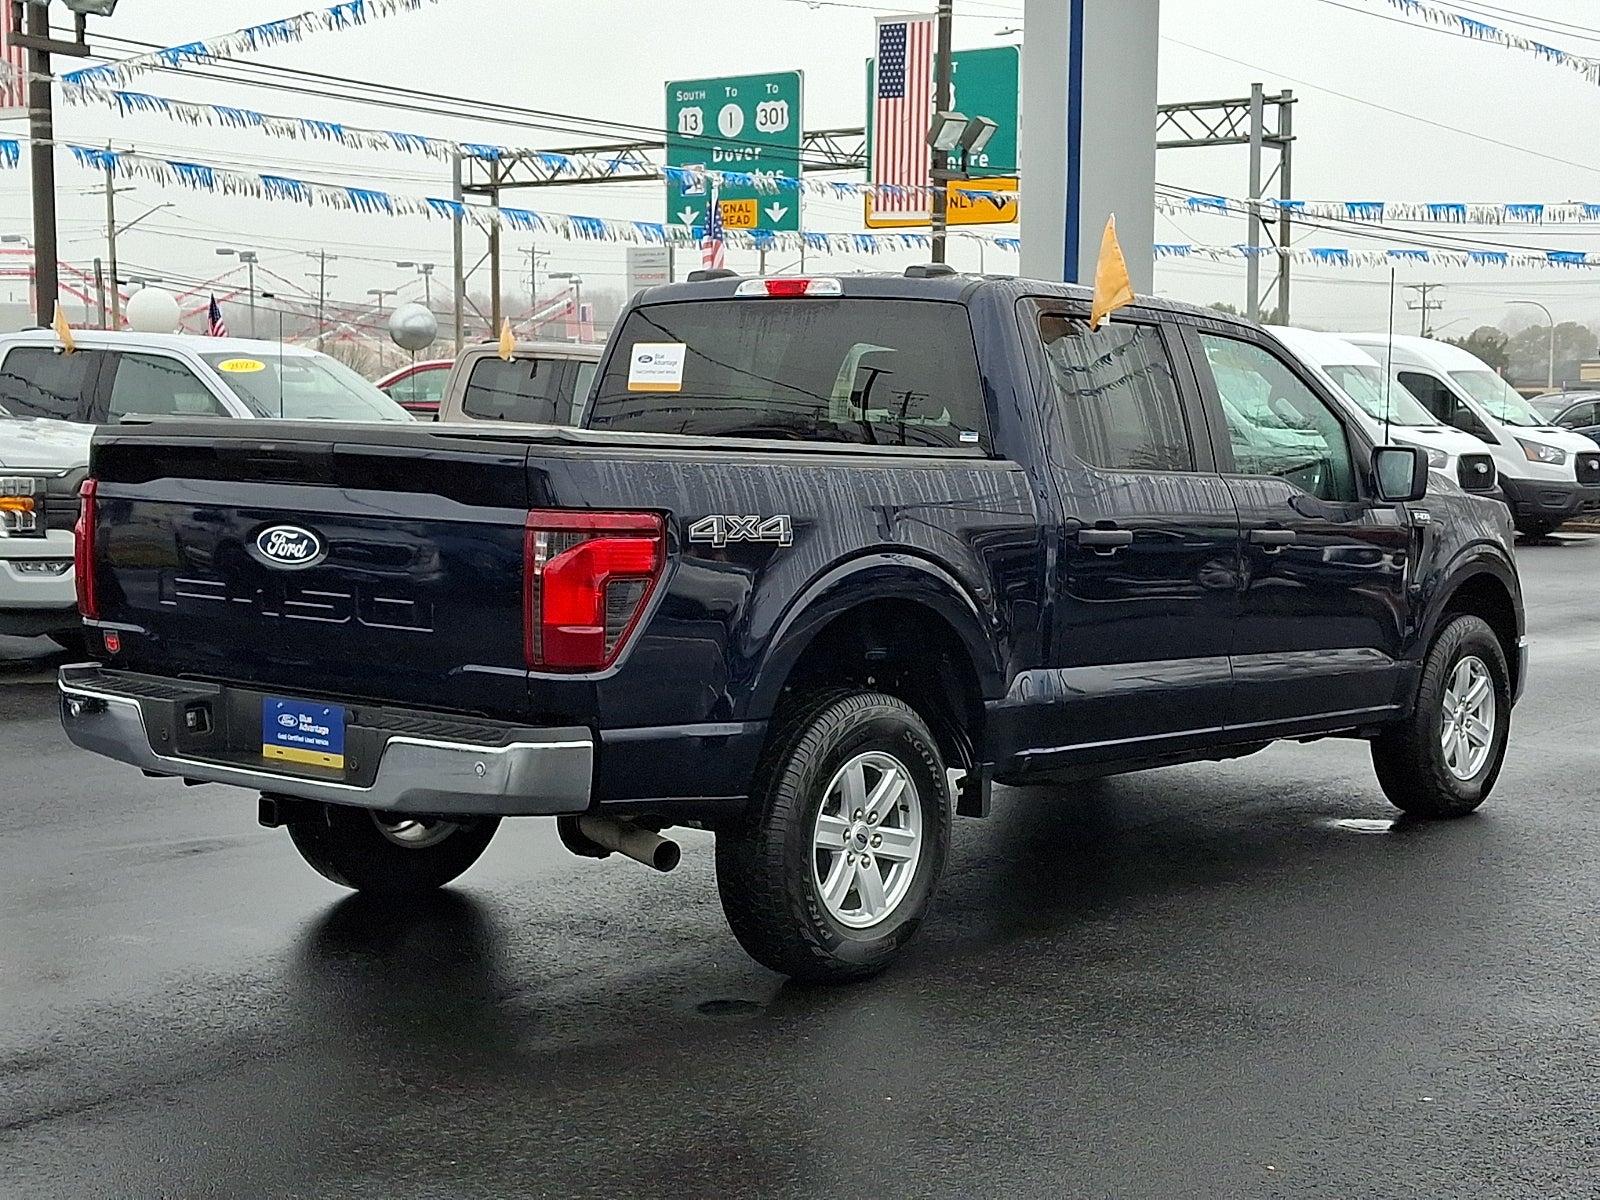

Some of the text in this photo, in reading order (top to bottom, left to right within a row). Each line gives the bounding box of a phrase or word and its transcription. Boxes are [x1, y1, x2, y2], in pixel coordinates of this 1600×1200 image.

[683, 113, 698, 131] 13
[729, 112, 733, 129] 1
[759, 107, 785, 126] 301
[712, 146, 762, 162] Dover
[721, 214, 751, 225] HEAD
[265, 529, 309, 558] Ford
[299, 722, 329, 735] Advantage
